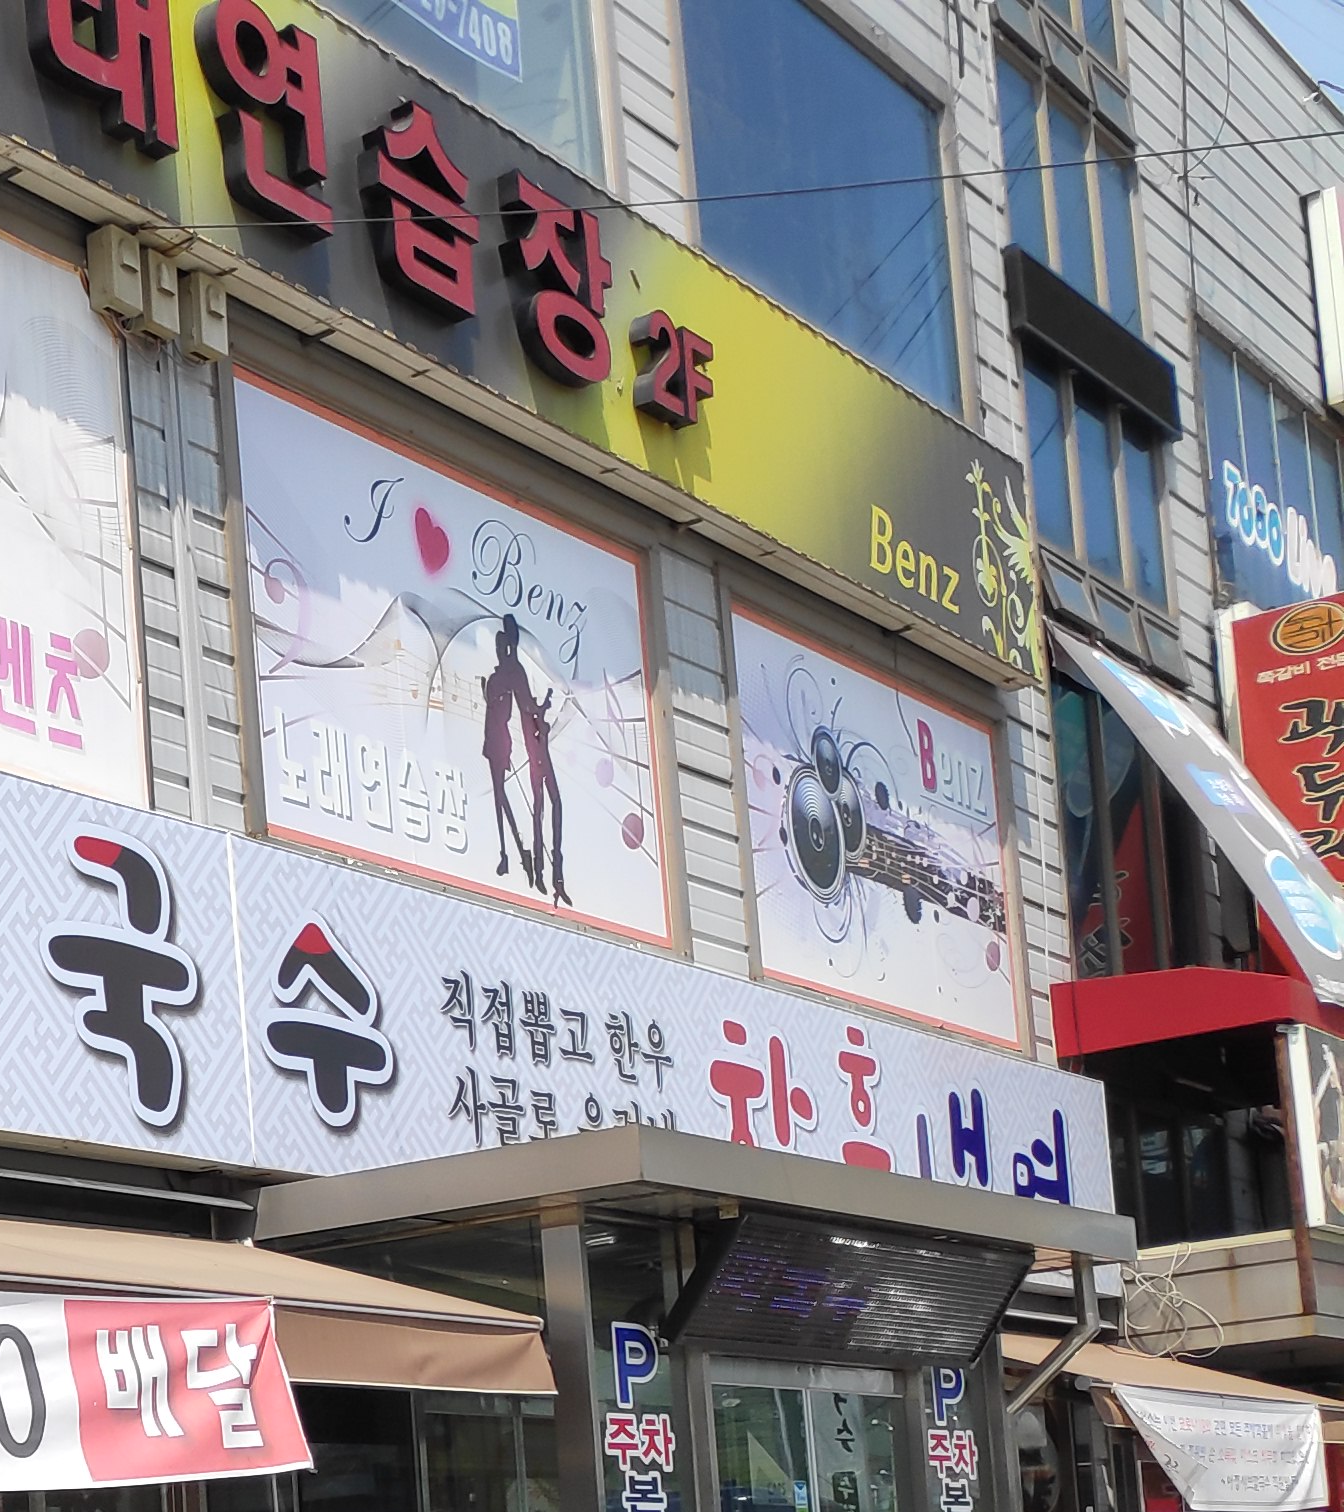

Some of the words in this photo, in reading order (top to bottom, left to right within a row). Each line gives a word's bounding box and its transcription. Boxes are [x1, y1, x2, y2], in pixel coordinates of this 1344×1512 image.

[630, 309, 713, 429] 2F
[471, 519, 587, 664] Benz
[869, 503, 961, 614] Benz
[274, 706, 470, 855] 노래연습장
[916, 718, 988, 826] Benz
[439, 969, 595, 1067] 직접뽑고
[604, 1008, 673, 1093] 한우
[95, 1321, 267, 1451] 배달
[611, 1321, 658, 1408] P
[605, 1412, 675, 1471] 주차
[927, 1429, 979, 1480] 주차
